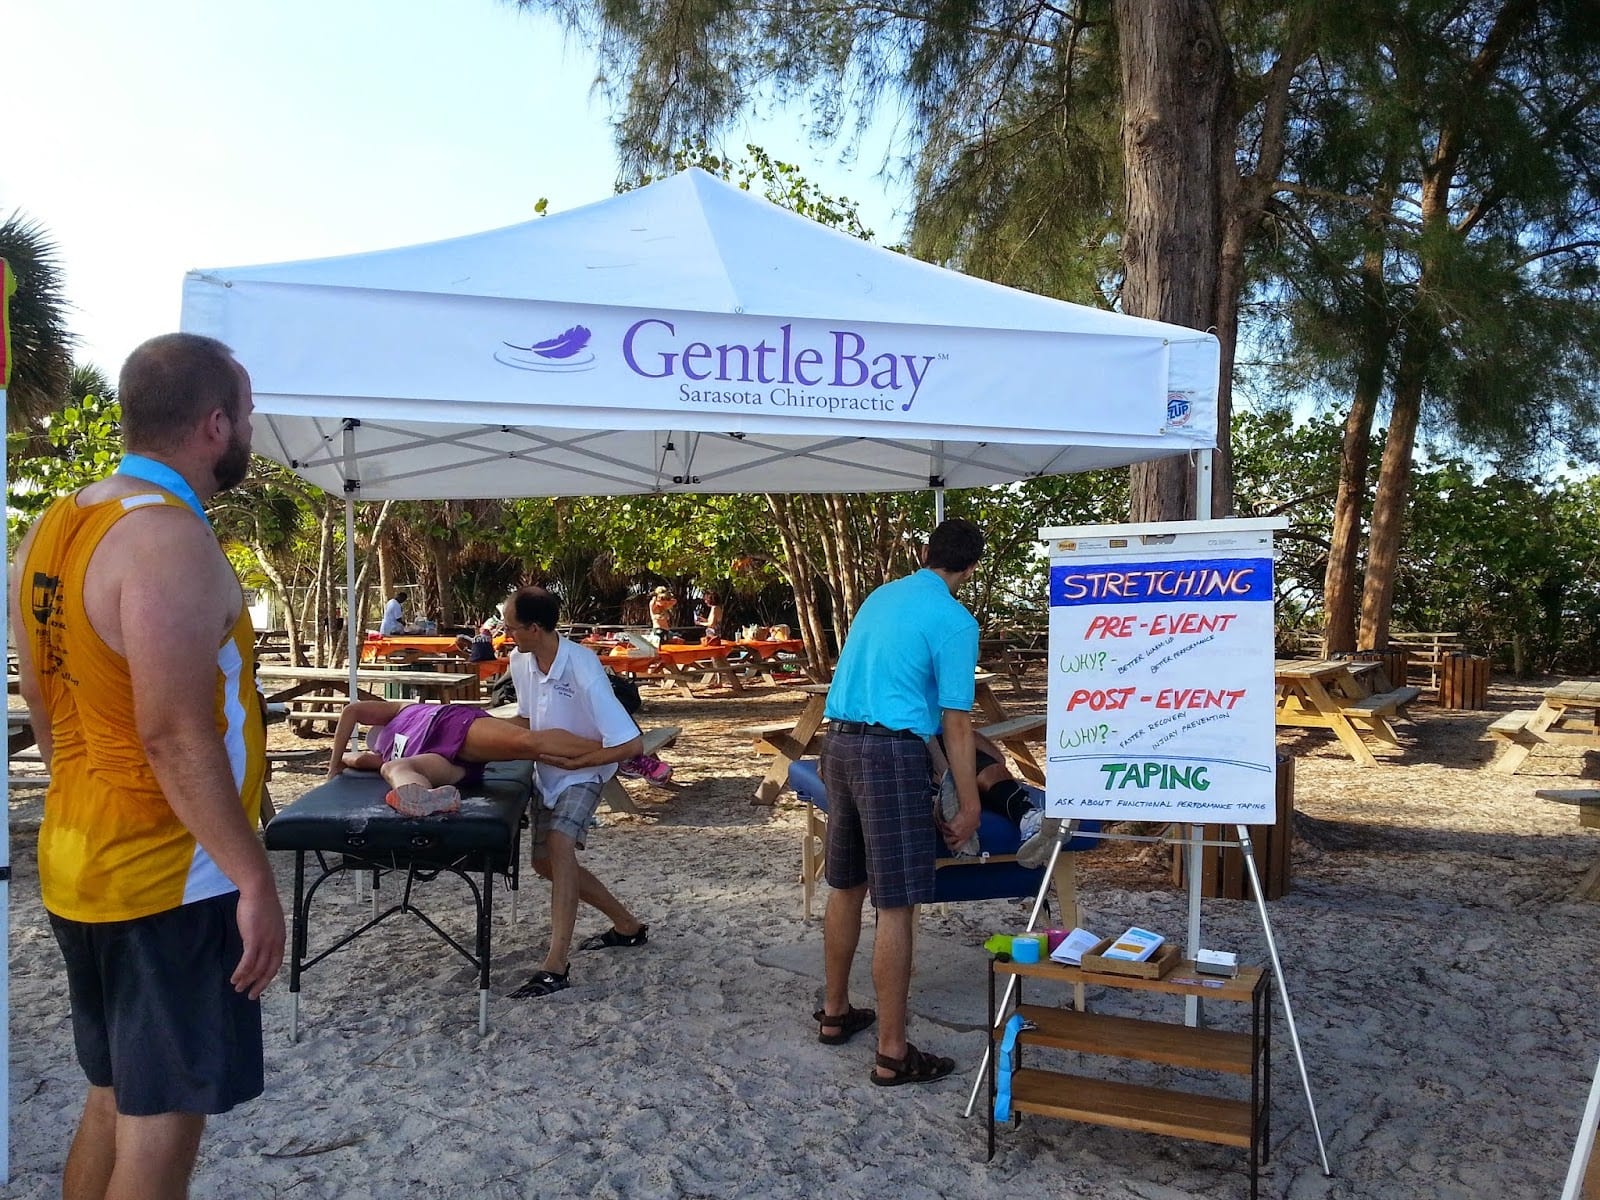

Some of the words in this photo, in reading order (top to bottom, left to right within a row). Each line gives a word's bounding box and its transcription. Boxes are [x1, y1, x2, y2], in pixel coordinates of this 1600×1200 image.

[679, 384, 763, 406] Sarasota
[770, 387, 895, 413] Chiropractic
[1064, 569, 1254, 599] STRETCHING
[1117, 653, 1145, 675] BETTER
[1150, 654, 1173, 674] BETTER
[1173, 634, 1215, 660] PERFORMANCE
[1119, 729, 1146, 749] FASTER
[1148, 711, 1187, 731] RECOVERY
[1152, 730, 1178, 751] INJURY
[1182, 711, 1230, 733] PREVENTION
[1100, 763, 1211, 791] TAPING
[1055, 798, 1075, 807] ASK
[1080, 799, 1111, 807] ABOUT
[1117, 799, 1172, 808] FUNCTIONAL
[1177, 801, 1233, 810] PERFORMANCE
[1236, 803, 1266, 811] TAPING
